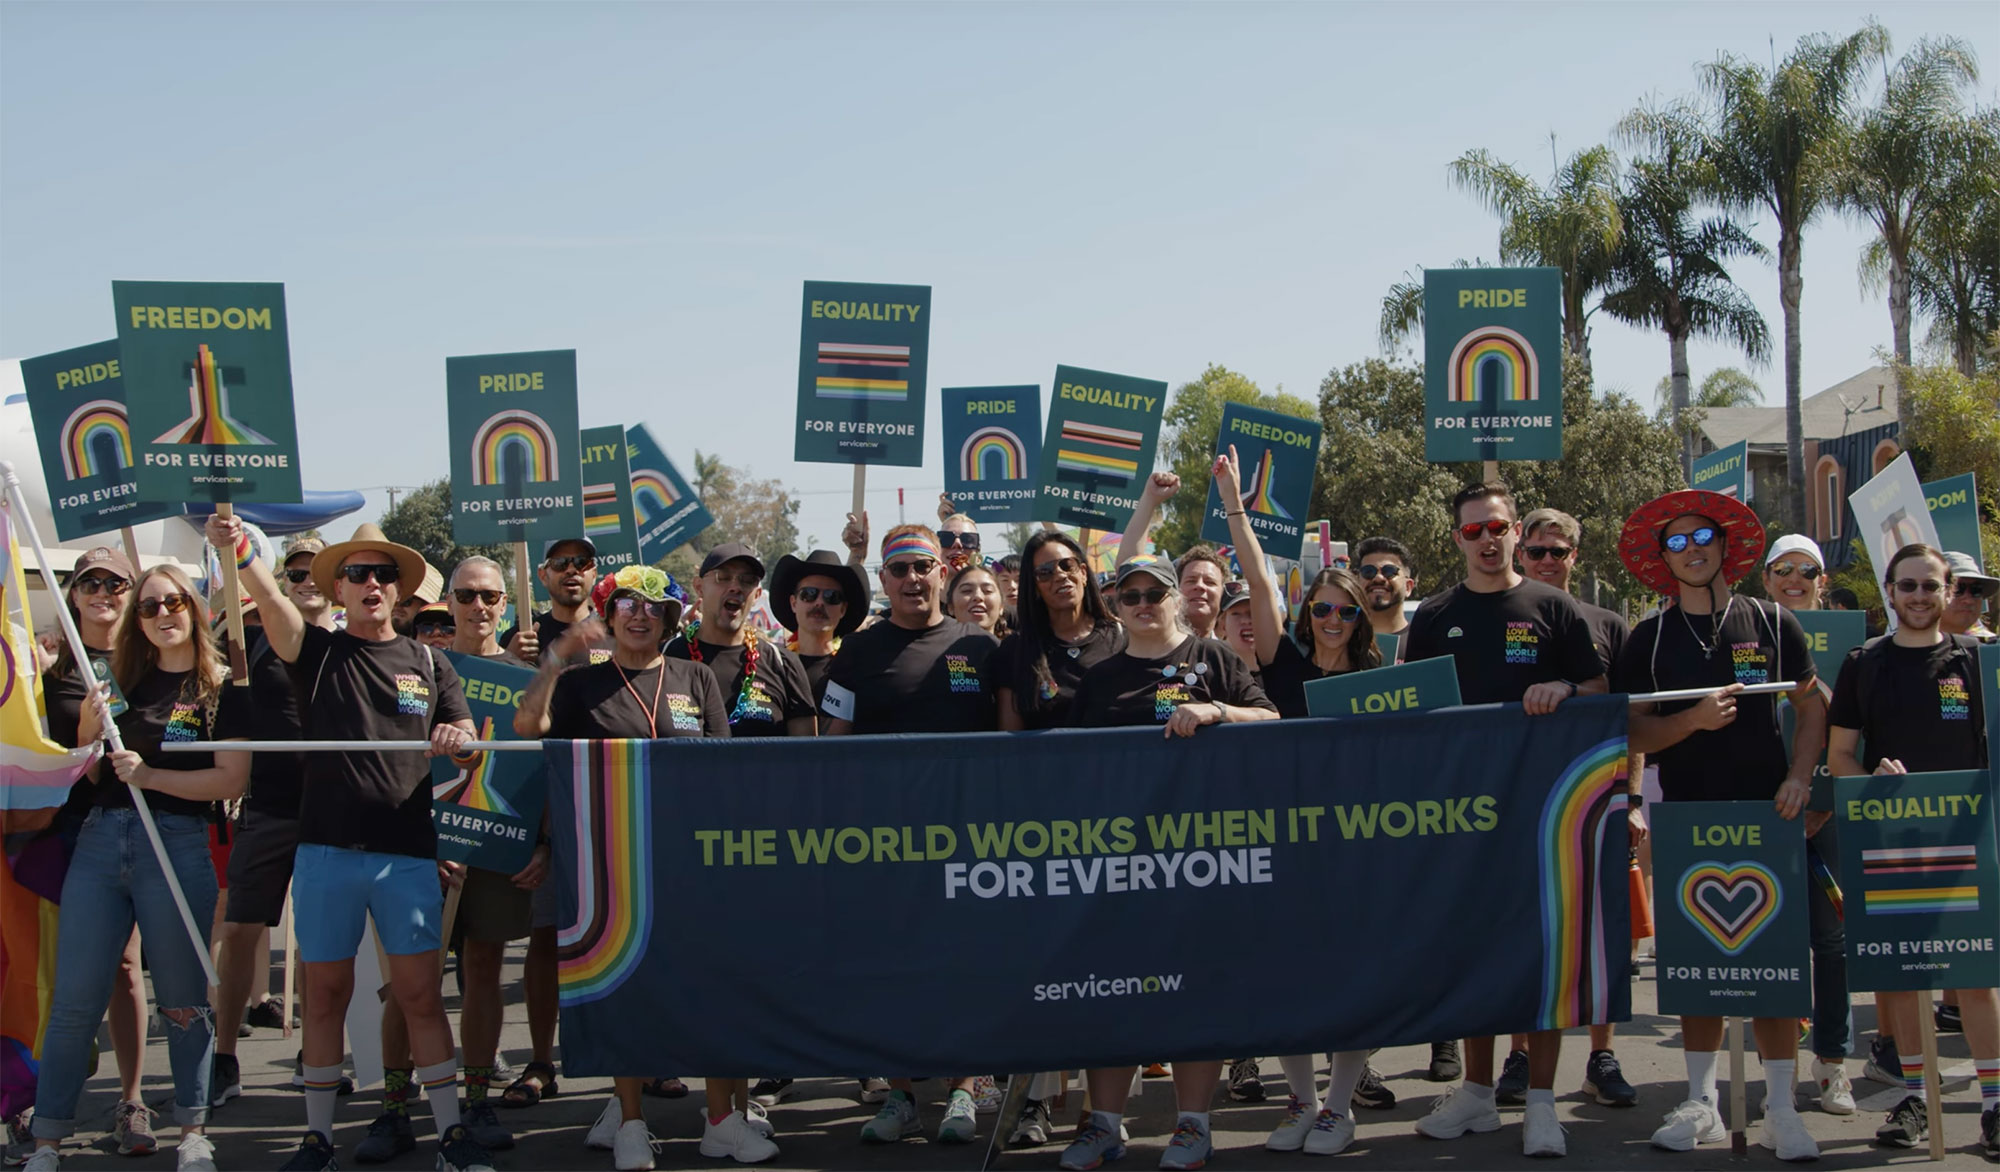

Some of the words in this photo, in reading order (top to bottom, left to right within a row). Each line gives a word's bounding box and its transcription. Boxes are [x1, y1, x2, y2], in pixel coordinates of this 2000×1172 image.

[1458, 289, 1527, 308] PRIDE
[811, 300, 920, 323] EQUALITY
[130, 306, 272, 330] FREEDOM
[56, 359, 121, 391] PRIDE
[479, 372, 544, 394] PRIDE
[1060, 382, 1157, 412] EQUALITY
[966, 400, 1016, 415] PRIDE
[805, 420, 834, 432] FOR
[839, 422, 915, 436] EVERYONE
[1435, 417, 1466, 429] FOR
[1471, 416, 1552, 428] EVERYONE
[1230, 417, 1312, 450] FREEDOM
[1472, 435, 1514, 443] servicenow
[839, 440, 879, 448] servicenow
[144, 453, 182, 467] FOR
[189, 454, 288, 468] EVERYONE
[1694, 454, 1742, 485] EQUALITY
[193, 475, 244, 484] servicenow
[59, 494, 89, 510] FOR
[93, 481, 138, 502] EVERY
[951, 492, 975, 501] FOR
[1043, 485, 1069, 498] FOR
[1073, 490, 1140, 510] EVERYONE
[461, 500, 491, 513] FOR
[496, 495, 574, 512] EVERYONE
[498, 517, 538, 526] servicenow
[1212, 508, 1228, 520] FO
[1248, 516, 1299, 536] VERYONE
[594, 553, 633, 568] RYONE
[1506, 628, 1528, 636] LOVE
[1506, 634, 1538, 643] WORKS
[1731, 642, 1759, 650] WHEN
[1505, 648, 1538, 656] WORLD
[1732, 648, 1756, 656] LOVE
[945, 654, 968, 662] WHEN
[1506, 656, 1537, 664] WORKS
[1733, 655, 1767, 663] WORKS
[948, 666, 976, 674] WORKS
[1734, 662, 1750, 670] THE
[394, 674, 422, 682] WHEN
[1734, 668, 1768, 678] WORLD
[396, 680, 418, 688] LOVE
[950, 678, 980, 686] WORLD
[397, 686, 429, 696] WORKS
[1939, 684, 1962, 692] LOVE
[666, 694, 690, 702] WHEN
[750, 694, 772, 702] ORKS
[824, 694, 841, 708] OVE
[1156, 692, 1189, 700] WORKS
[1350, 686, 1419, 714] LOVE
[398, 698, 428, 709] WORLD
[1940, 698, 1956, 706] THE
[1941, 705, 1968, 713] WORLD
[168, 720, 184, 728] THE
[166, 726, 198, 737] WORLD
[1847, 794, 1983, 821] EQUALITY
[440, 811, 527, 841] EVERYONE
[695, 829, 778, 866] THE
[787, 824, 957, 865] WORLD
[967, 817, 1137, 859] WORKS
[1146, 808, 1276, 850] WHEN
[1288, 806, 1325, 843] IT
[1334, 795, 1499, 840] WORKS
[438, 833, 483, 848] servicenow
[1692, 824, 1761, 846] LOVE
[944, 860, 1036, 899] FOR
[1046, 847, 1273, 896] EVERYONE
[1857, 942, 1893, 956] FOR
[1899, 938, 1994, 955] EVERYONE
[1901, 961, 1950, 971] servicenow
[1667, 966, 1702, 981] FOR
[1708, 967, 1800, 982] EVERYONE
[1034, 973, 1183, 1001] servicenow
[1709, 988, 1757, 997] servicenow
